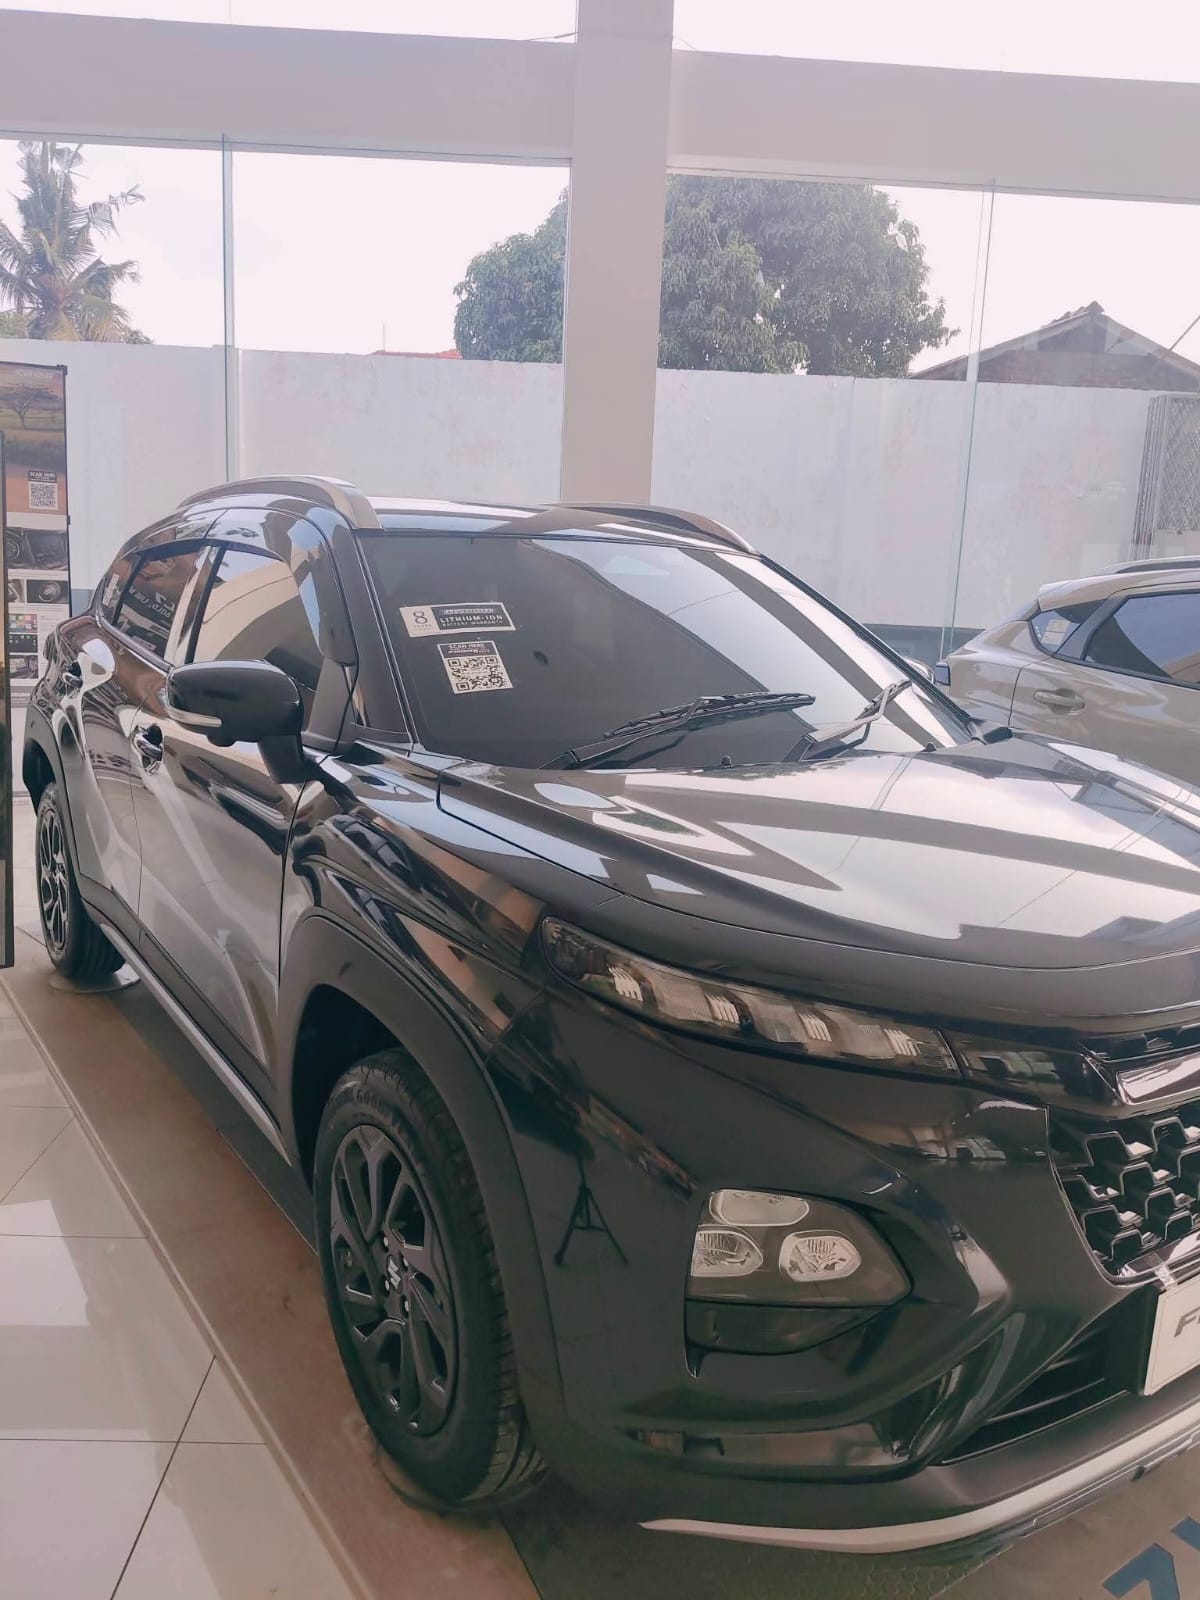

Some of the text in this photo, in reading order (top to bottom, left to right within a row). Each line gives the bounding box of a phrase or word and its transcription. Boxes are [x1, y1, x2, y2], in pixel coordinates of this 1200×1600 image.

[413, 611, 428, 624] 8
[440, 615, 503, 623] LITHIUM-ION
[1174, 1306, 1200, 1338] F
